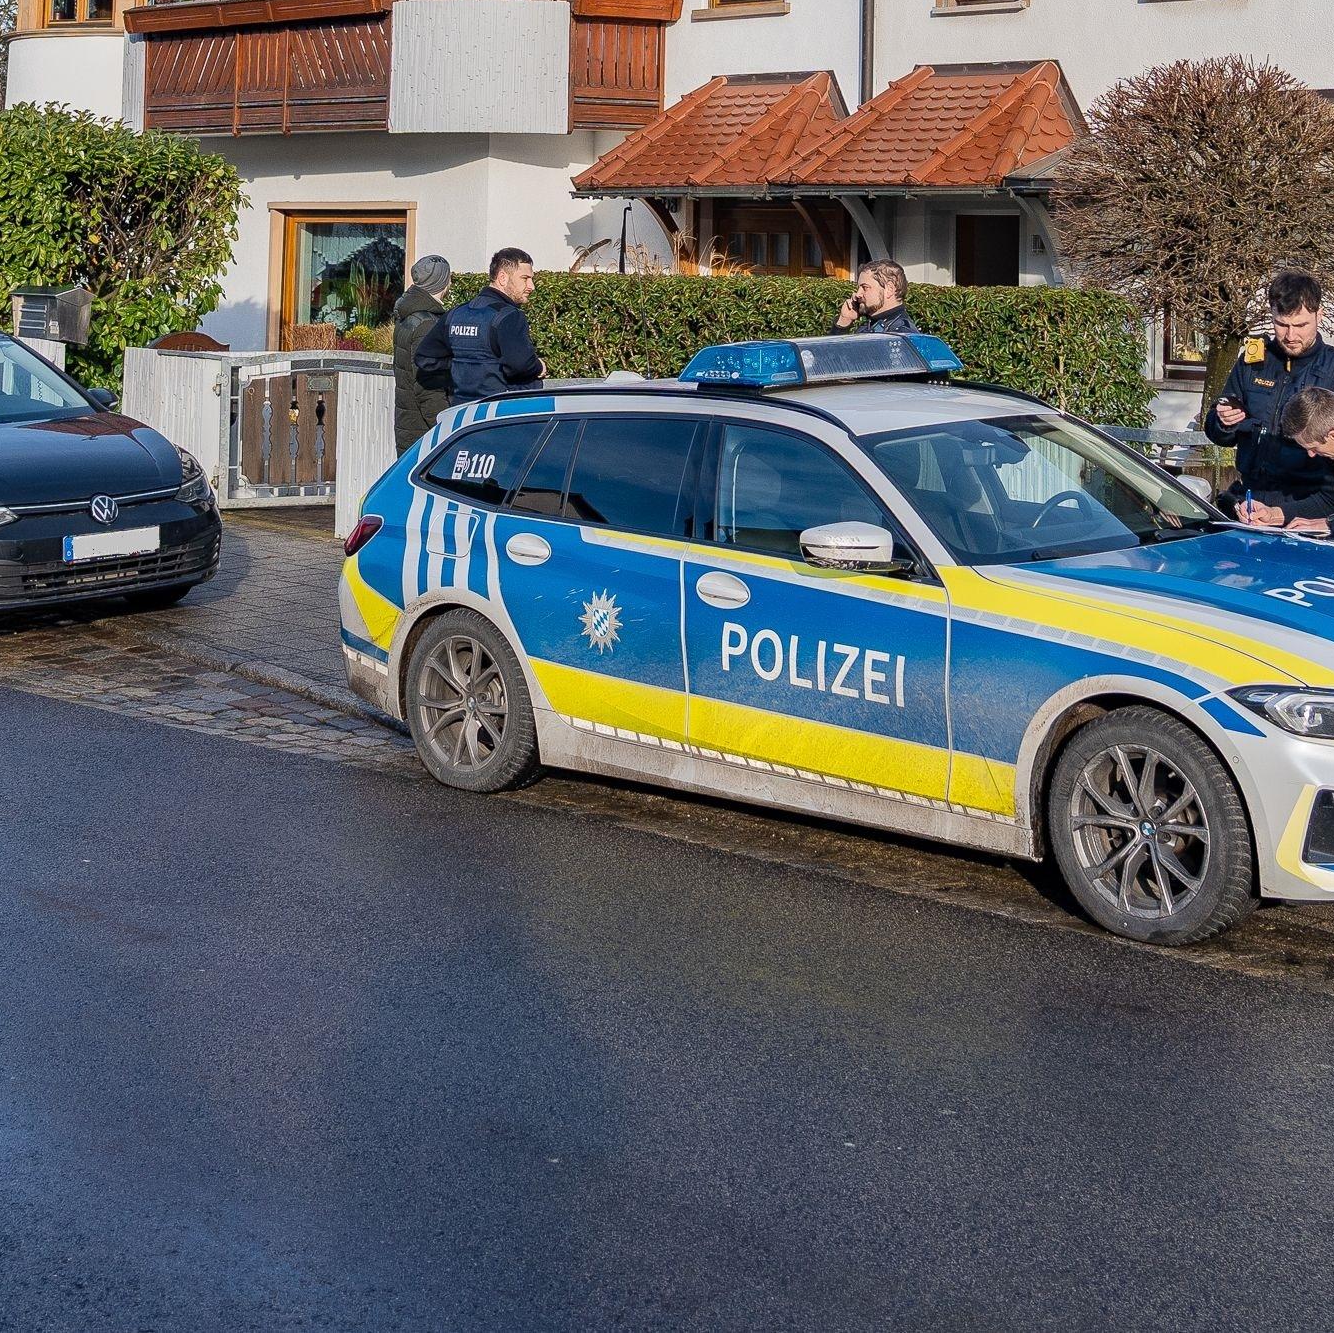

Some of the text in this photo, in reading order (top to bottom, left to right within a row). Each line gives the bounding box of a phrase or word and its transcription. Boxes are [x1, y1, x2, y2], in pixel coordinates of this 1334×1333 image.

[450, 325, 478, 336] POLIZEI
[1254, 377, 1276, 387] POLIZEI
[467, 453, 496, 479] 110
[721, 621, 906, 708] POLIZEI
